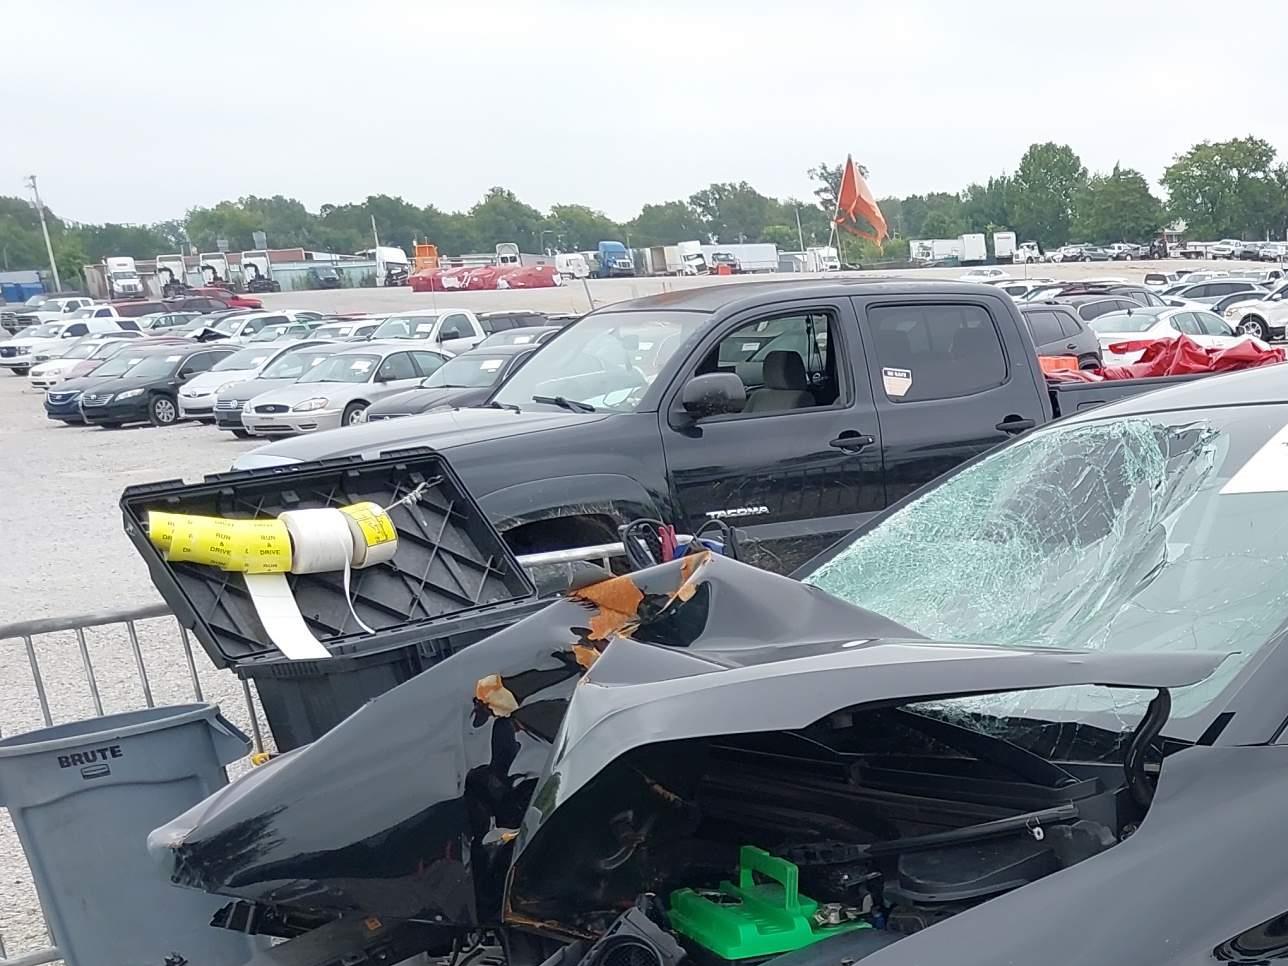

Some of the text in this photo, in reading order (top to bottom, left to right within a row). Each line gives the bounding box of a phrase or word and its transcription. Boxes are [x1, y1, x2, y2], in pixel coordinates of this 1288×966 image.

[705, 506, 770, 519] TACOMA
[209, 546, 232, 556] DRIVE
[57, 745, 123, 769] BRUTE
